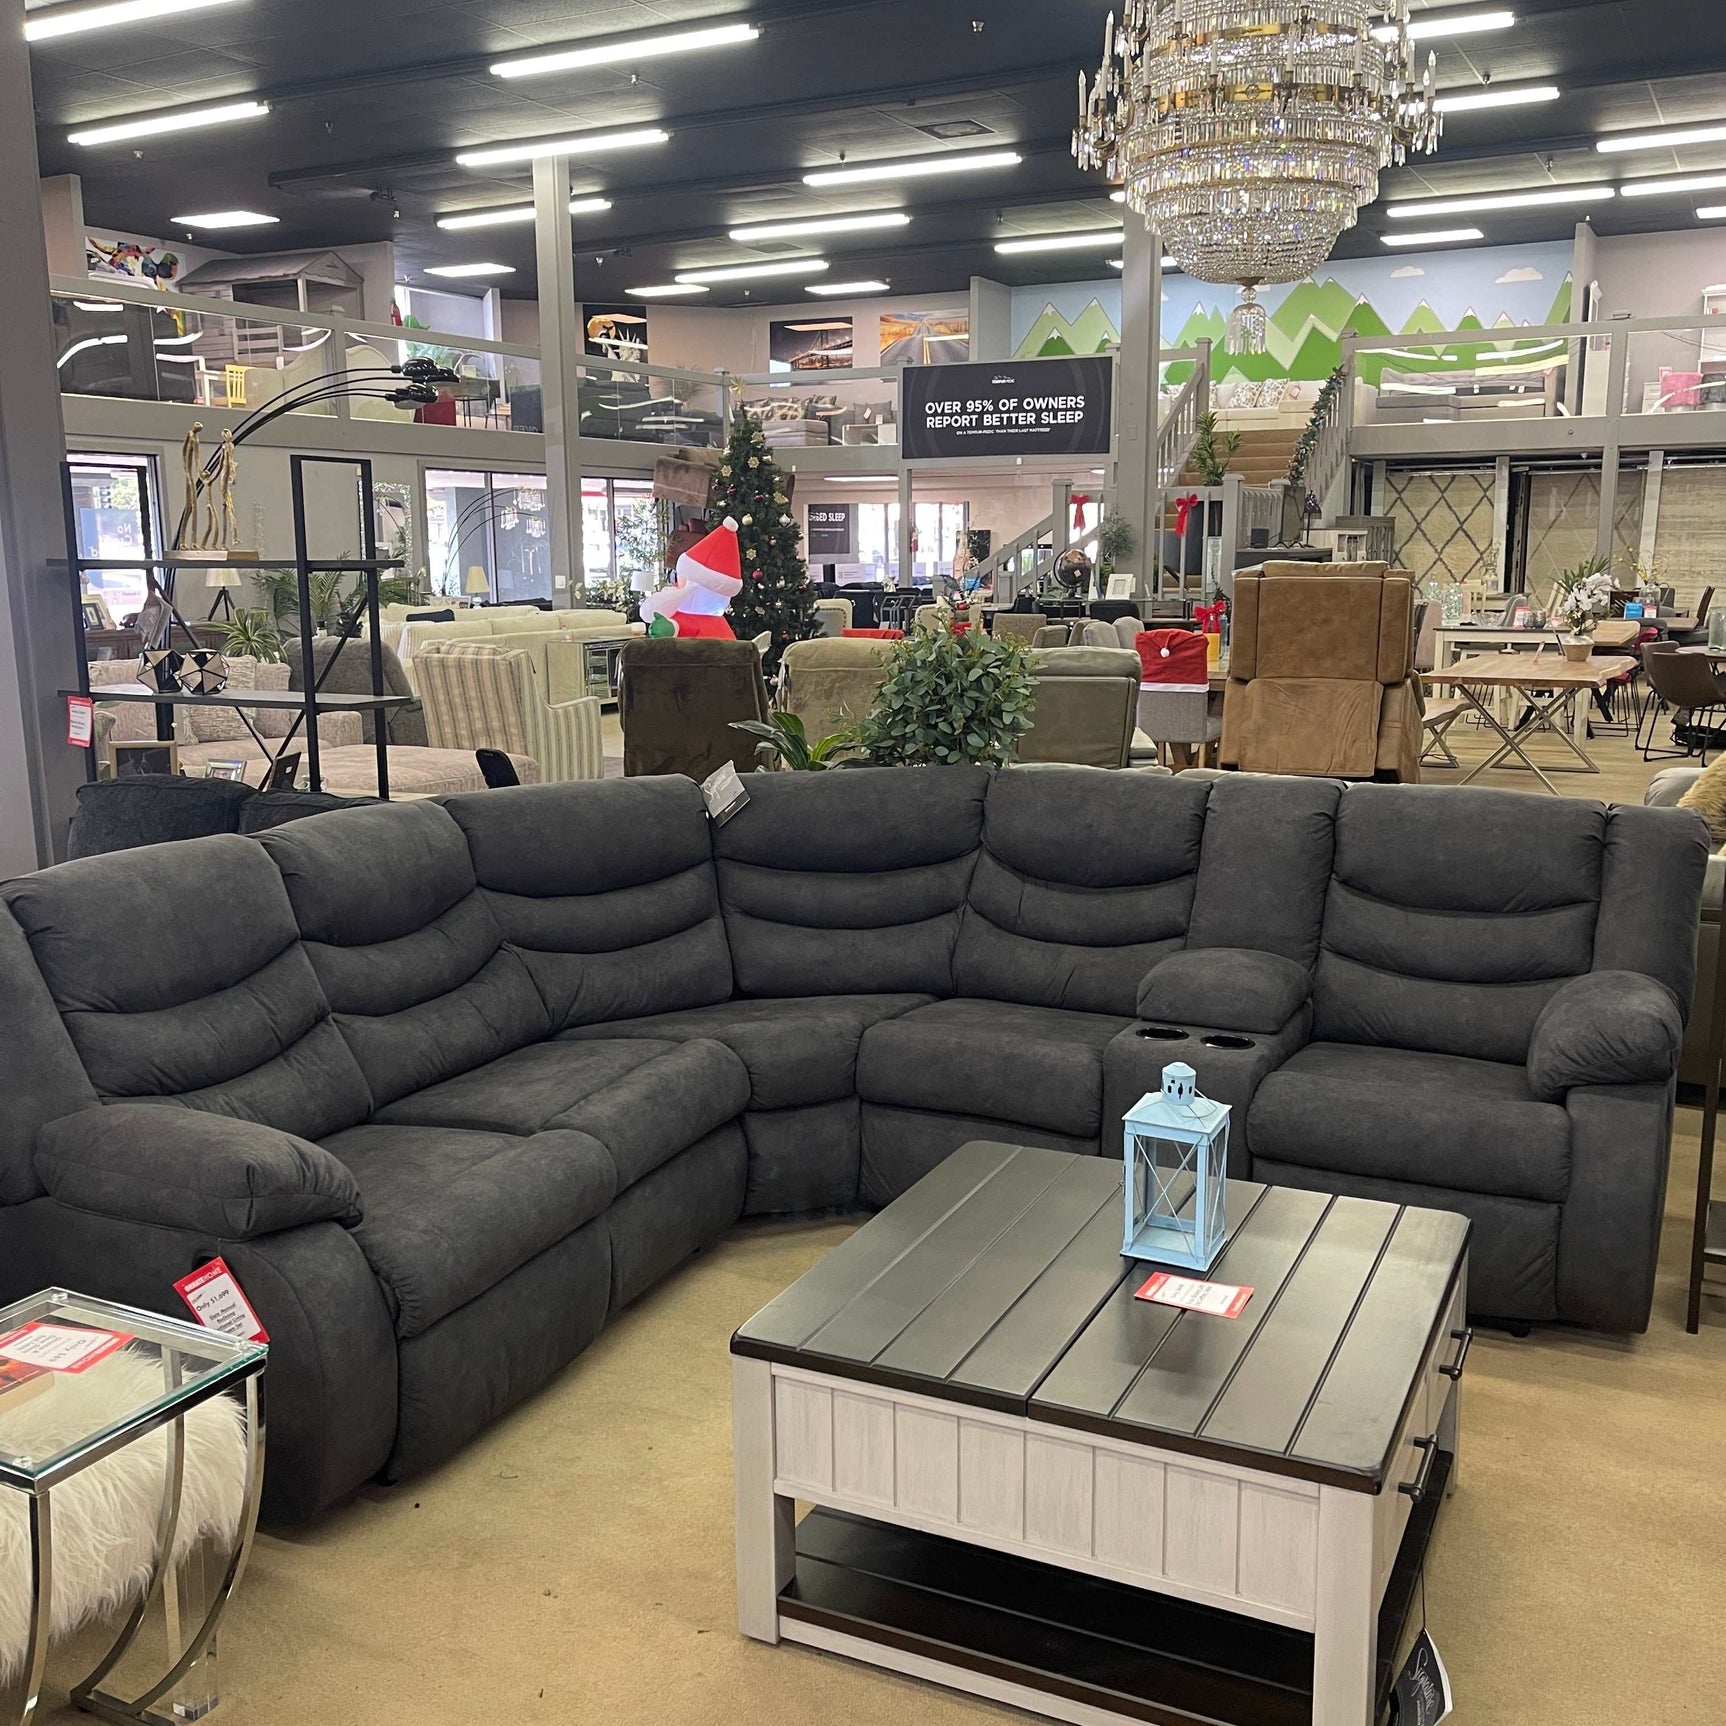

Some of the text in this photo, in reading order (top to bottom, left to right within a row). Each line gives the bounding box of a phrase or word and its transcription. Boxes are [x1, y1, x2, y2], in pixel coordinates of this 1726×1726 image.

[925, 395, 1085, 414] OVER 95% OF OWNERS
[926, 410, 1084, 428] REPORT BETTER SLEEP
[828, 512, 846, 521] SLEEP
[196, 1301, 210, 1312] Only
